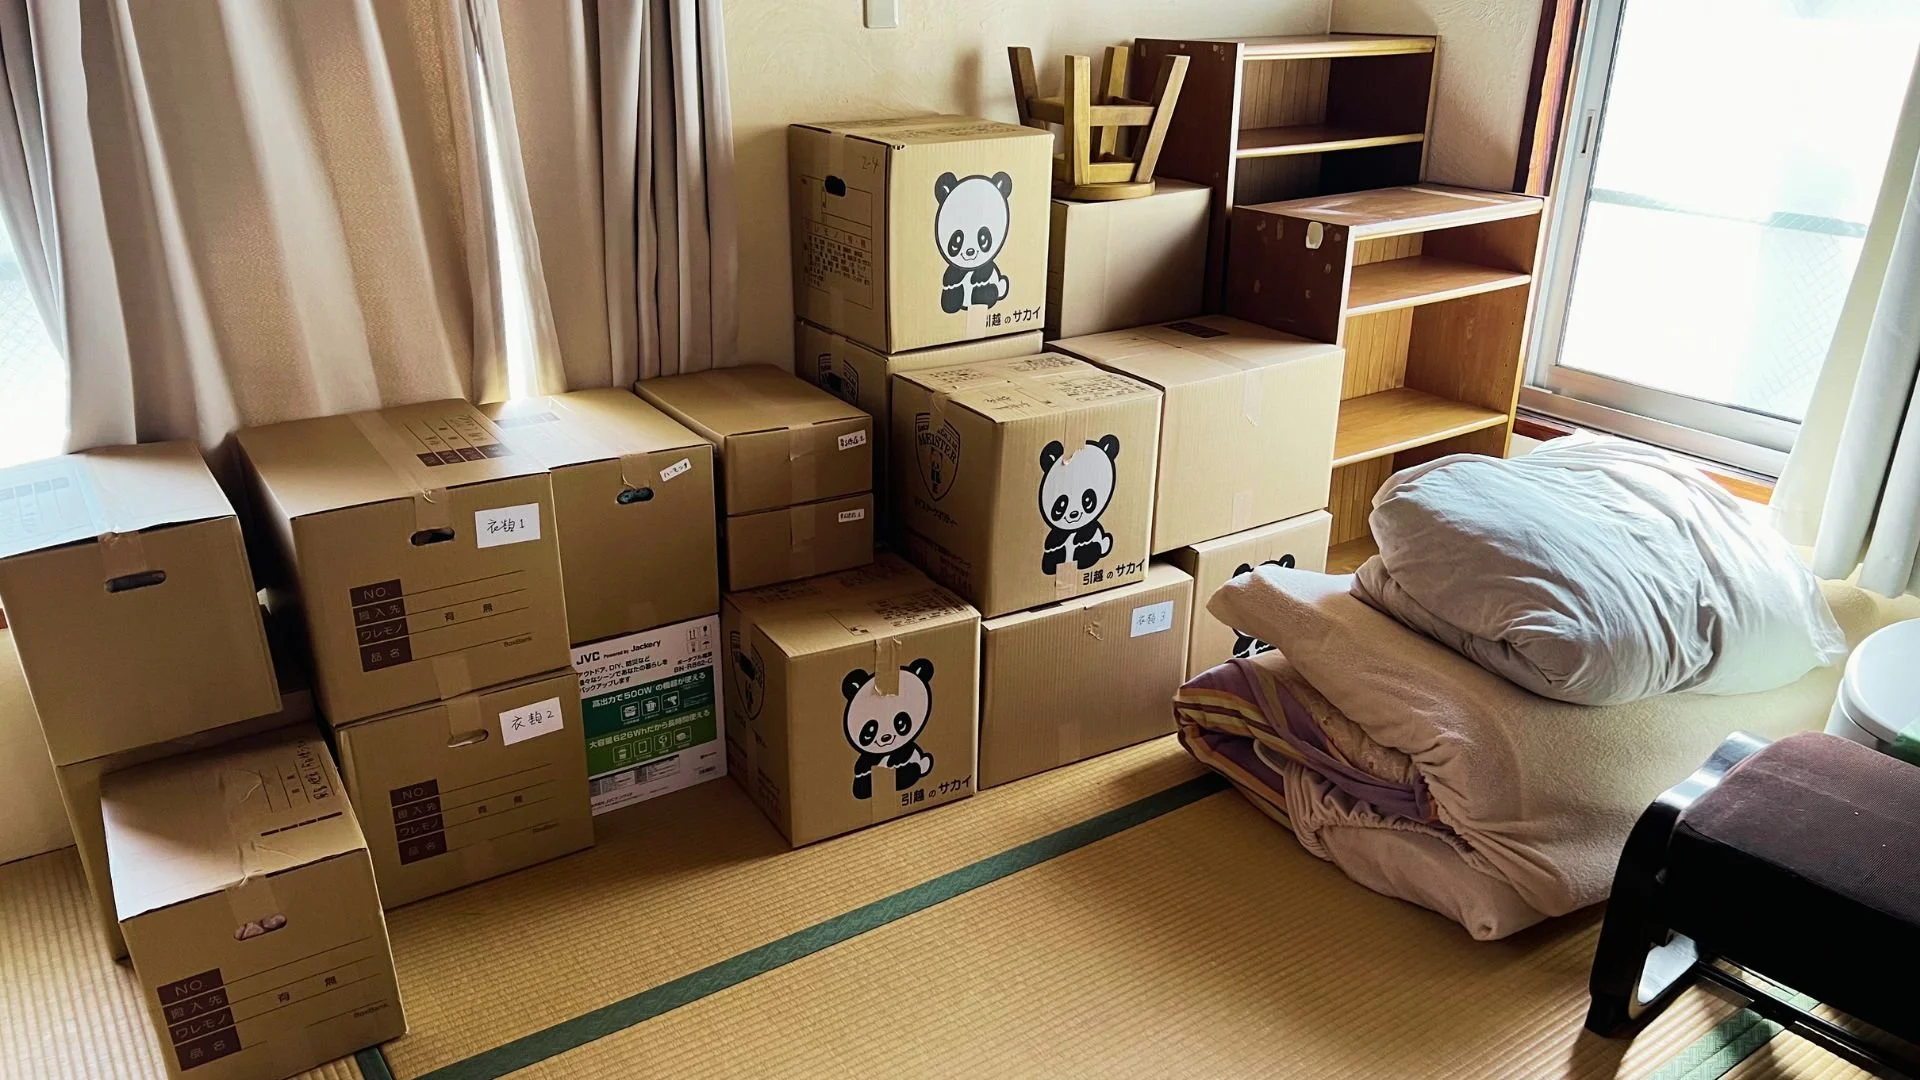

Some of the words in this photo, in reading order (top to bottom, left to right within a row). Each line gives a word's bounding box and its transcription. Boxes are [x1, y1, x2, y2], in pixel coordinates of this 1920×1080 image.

[361, 624, 404, 640] ワレモノ
[444, 611, 456, 623] 有
[482, 602, 494, 614] 無
[371, 647, 401, 663] 品名
[576, 651, 601, 666] JVC
[630, 640, 662, 653] Jackery
[901, 775, 972, 807] 引越のサカイ
[175, 1013, 228, 1039] ワレモノ
[277, 991, 291, 1004] 有
[324, 975, 338, 987] 無
